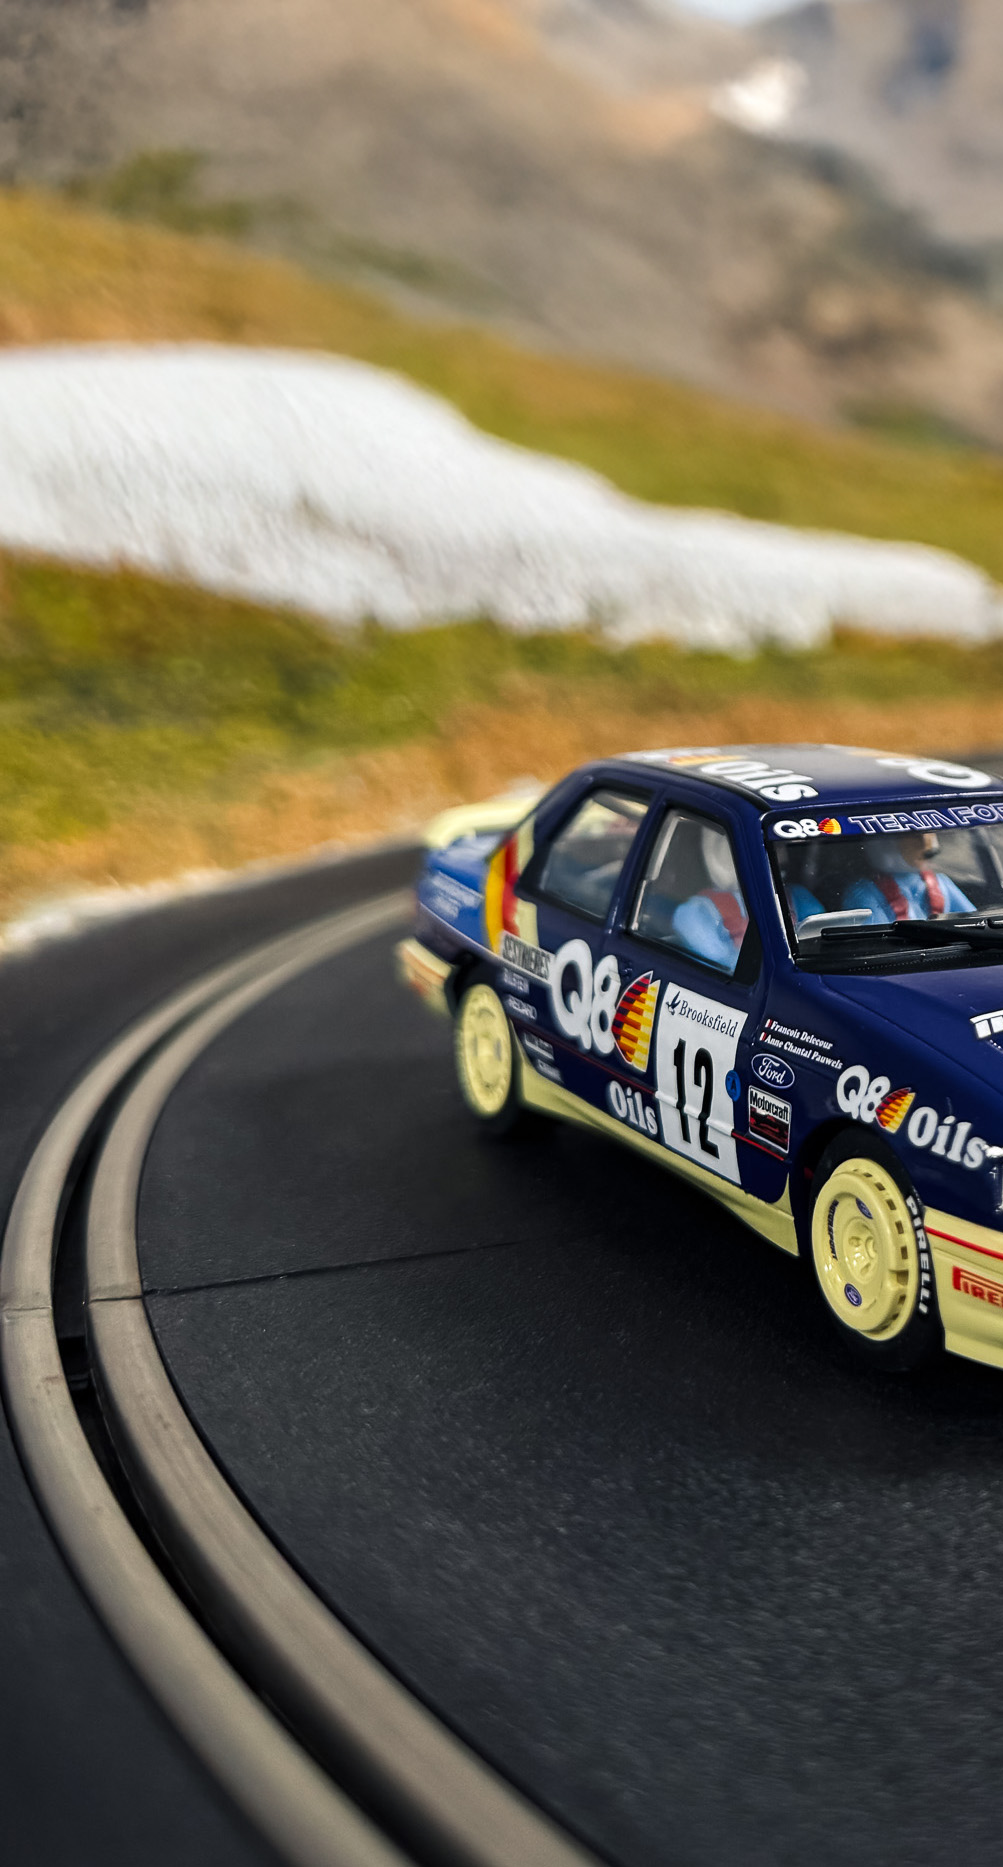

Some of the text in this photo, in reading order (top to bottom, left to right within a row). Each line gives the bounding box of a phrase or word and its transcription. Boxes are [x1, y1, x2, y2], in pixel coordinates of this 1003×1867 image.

[701, 761, 818, 802] Oils
[773, 818, 821, 838] Q8
[849, 810, 956, 834] TEAM
[552, 938, 622, 1054] Q8
[679, 1000, 738, 1038] Brooksfield
[771, 1021, 833, 1050] Francois Delecour
[758, 1056, 787, 1085] Ford
[765, 1034, 844, 1069] Anne Chantal Pauwels
[609, 1081, 659, 1136] Oils
[673, 1038, 720, 1159] 12
[750, 1090, 789, 1122] Motorcraft
[836, 1065, 987, 1168] Q8 Oils
[906, 1195, 931, 1315] PIRELLI
